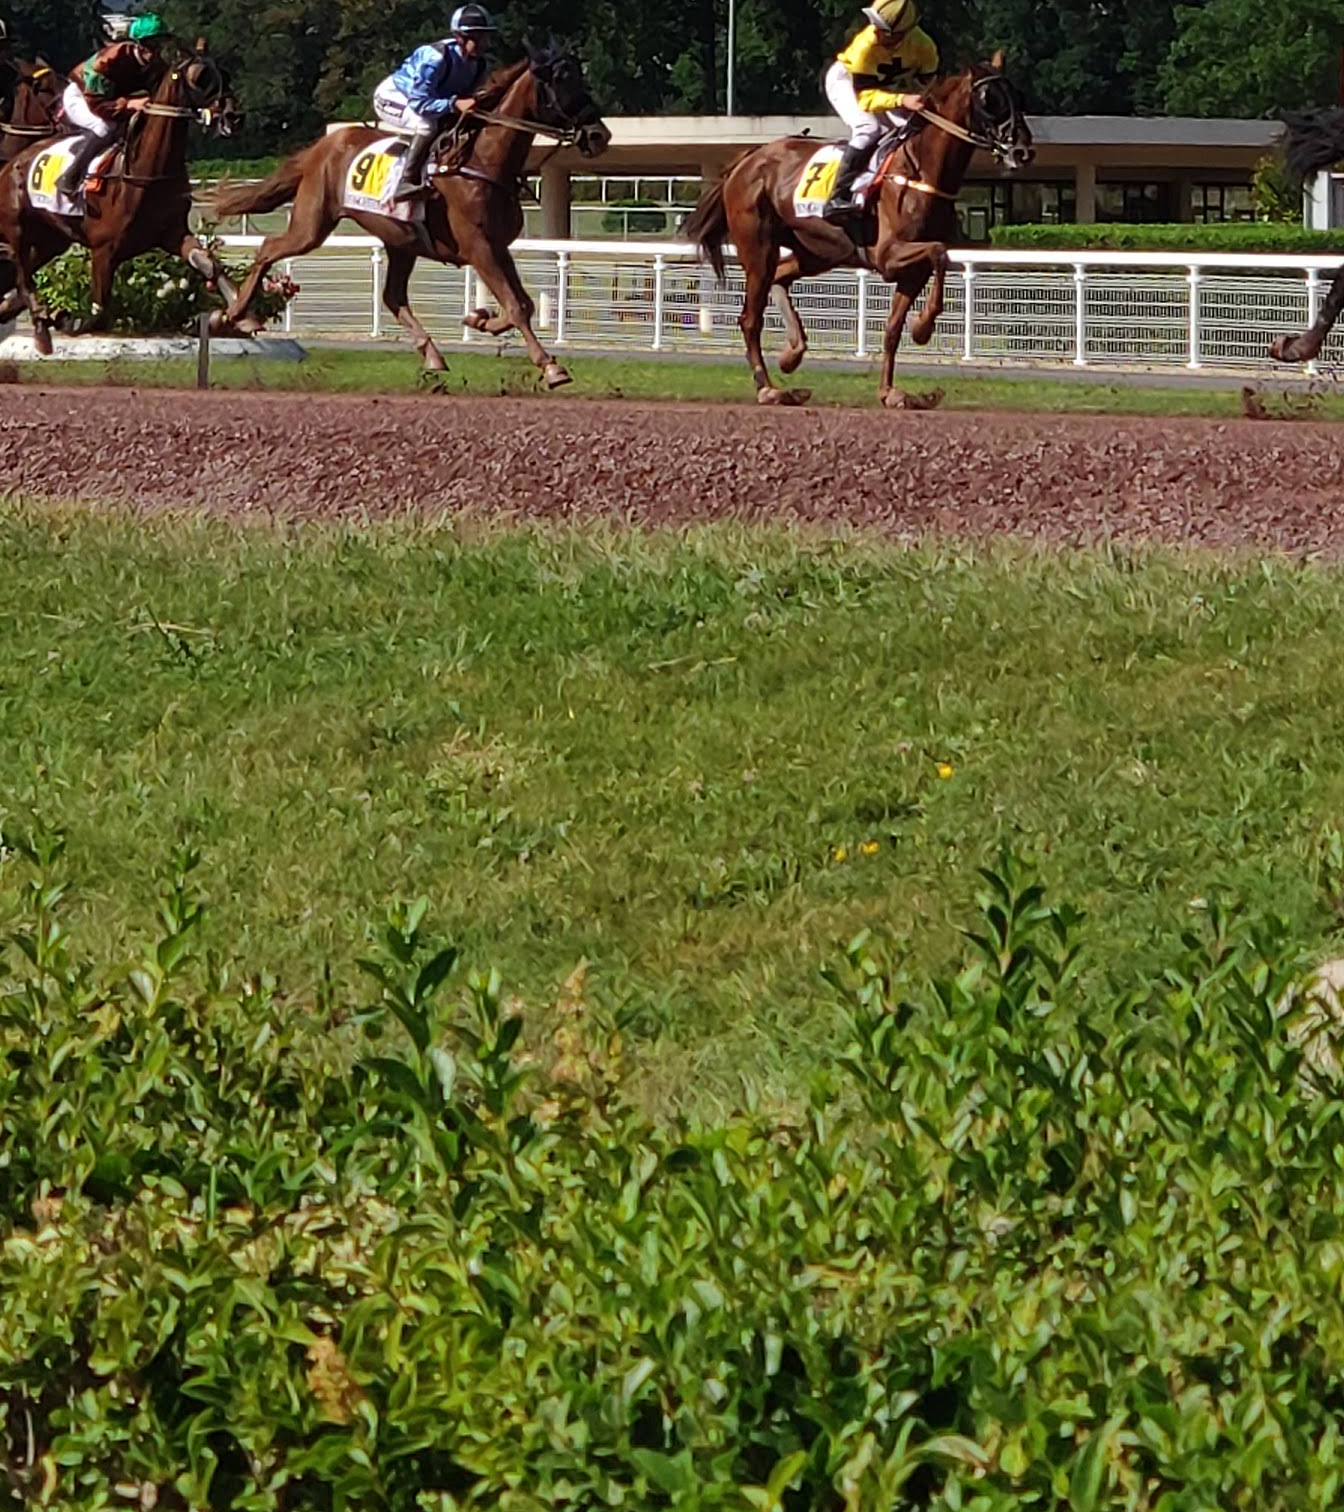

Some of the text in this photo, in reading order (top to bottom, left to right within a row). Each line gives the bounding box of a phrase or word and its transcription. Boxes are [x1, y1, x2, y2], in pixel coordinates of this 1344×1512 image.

[32, 153, 52, 191] 6
[351, 152, 377, 191] 9
[801, 162, 829, 198] 7
